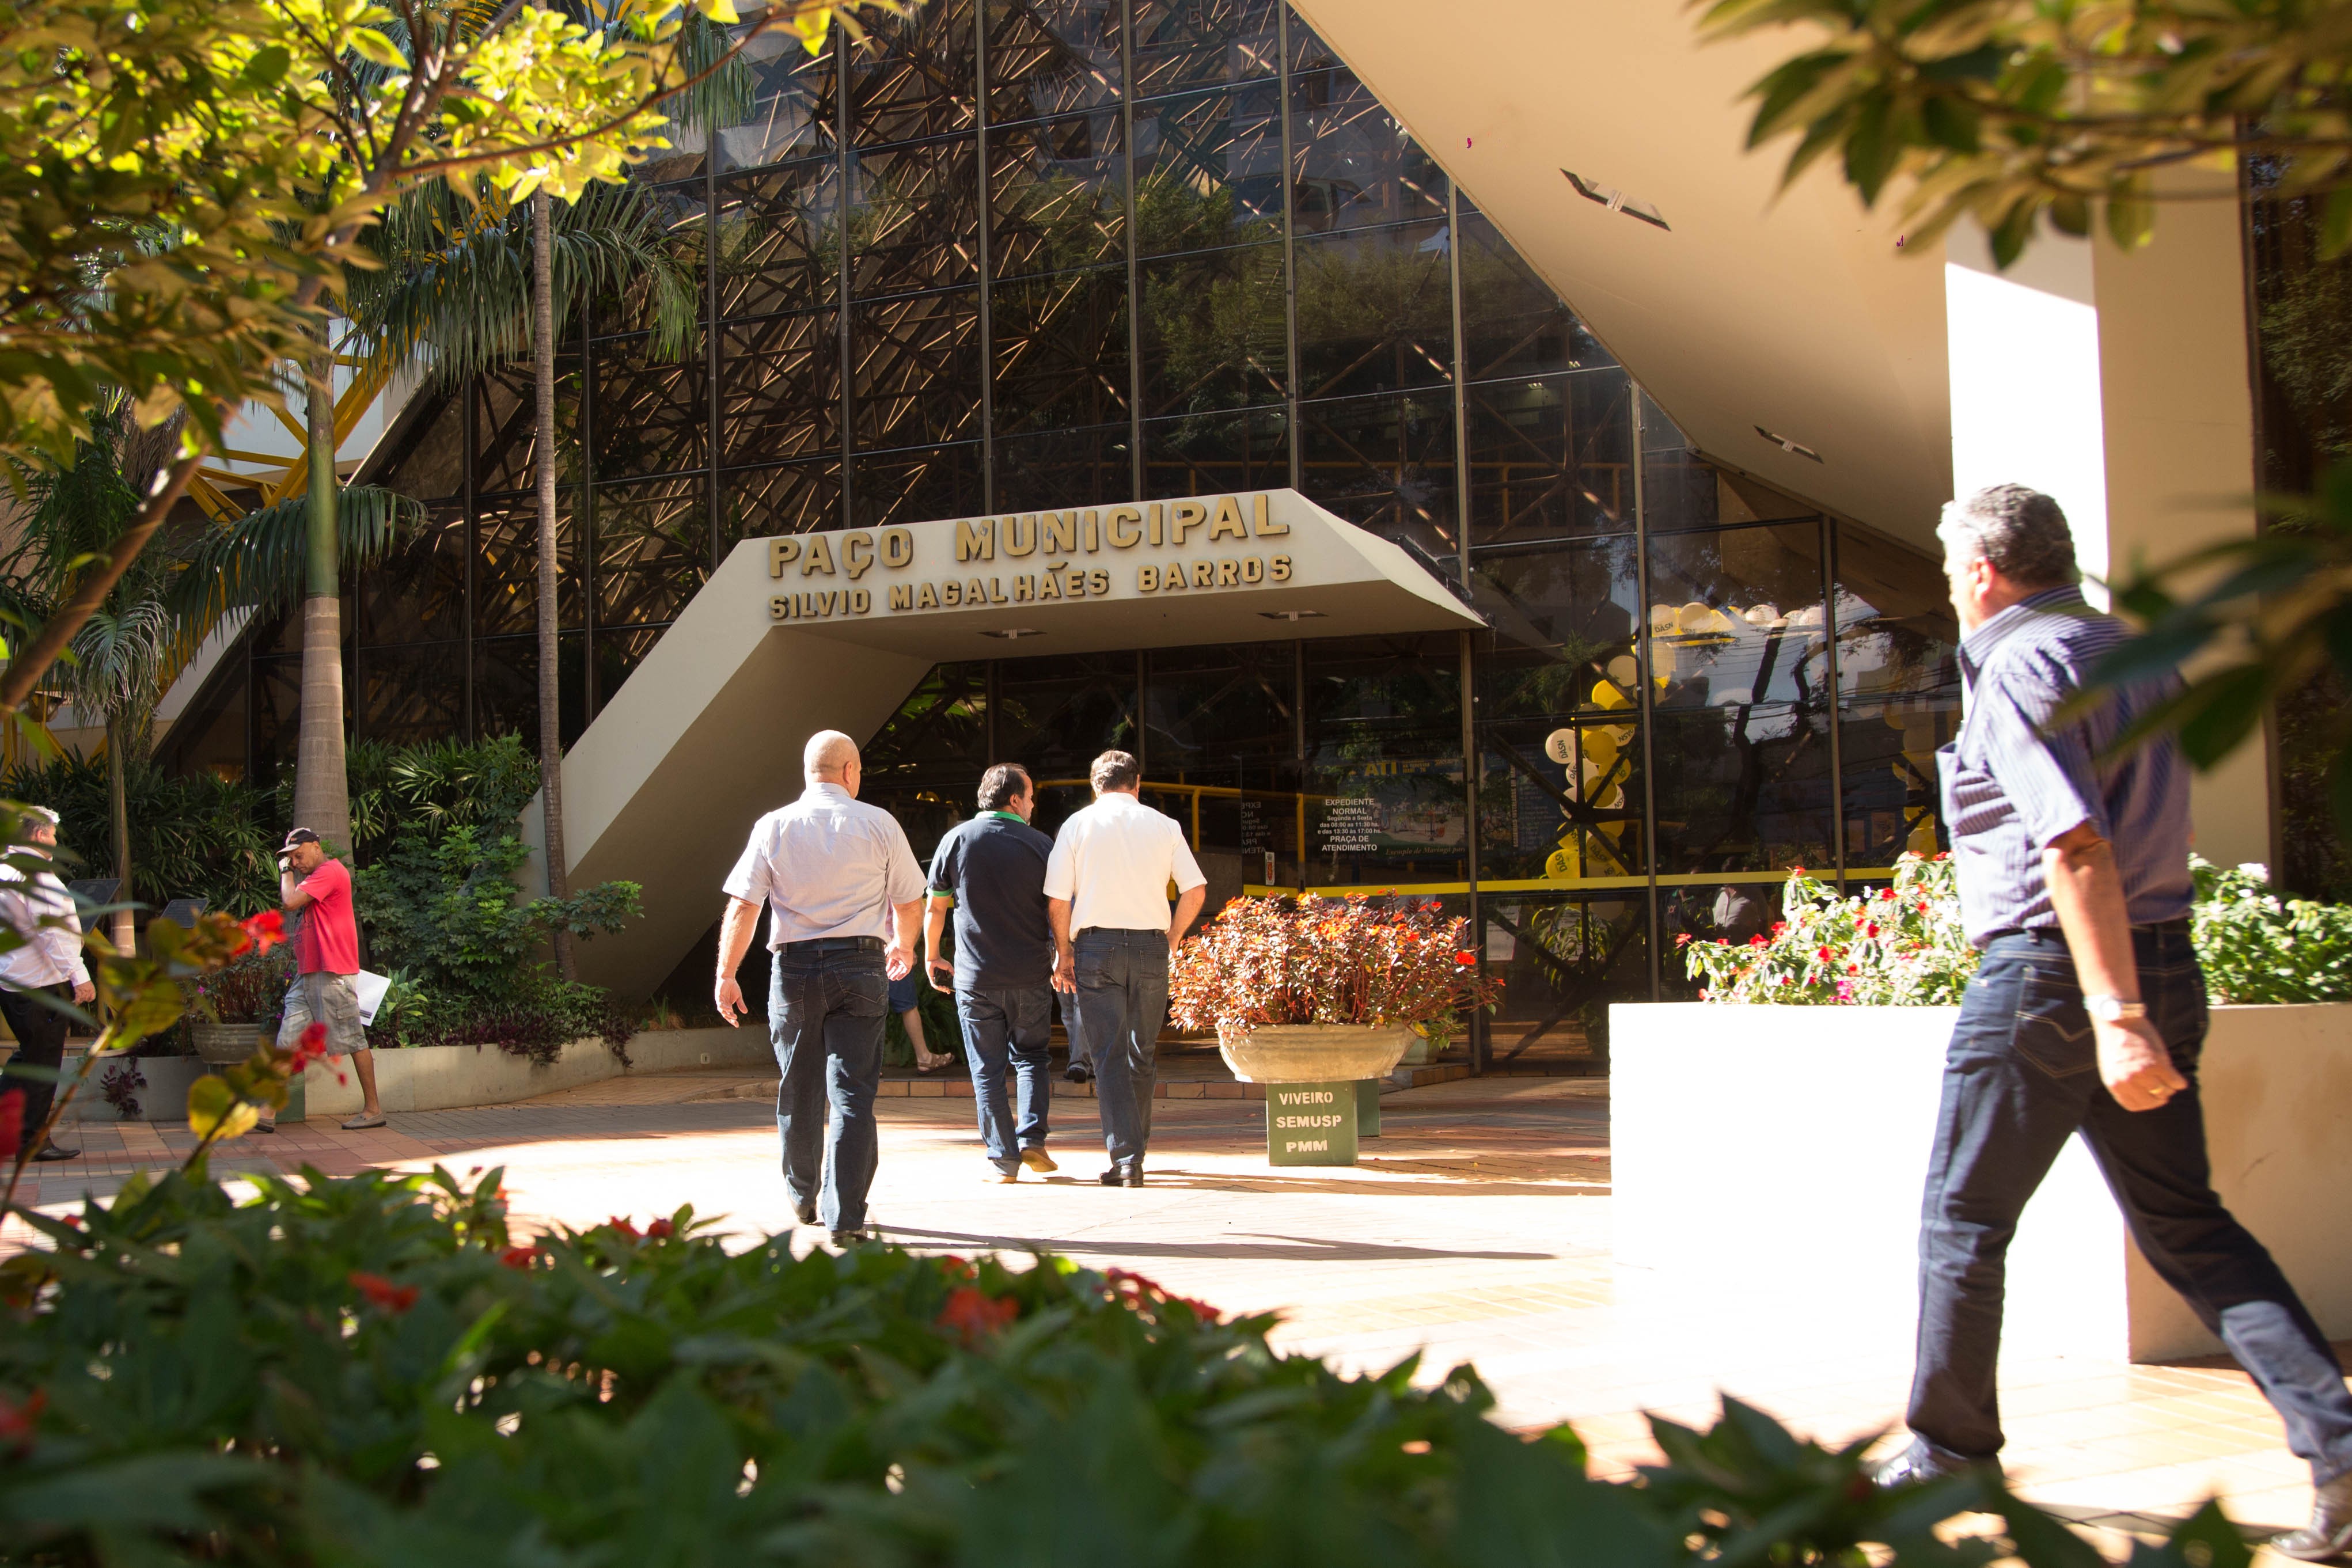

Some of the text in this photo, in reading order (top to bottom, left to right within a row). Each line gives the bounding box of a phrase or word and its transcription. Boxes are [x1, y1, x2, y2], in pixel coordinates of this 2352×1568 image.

[769, 494, 1290, 579] PAÇO MUNICIPAL
[769, 589, 871, 619] SILVIO
[1138, 555, 1292, 591] BARROS
[1655, 622, 1674, 632] DASN
[1557, 739, 1568, 758] DASN
[1279, 1092, 1333, 1105] VIVEIRO
[1276, 1115, 1342, 1128] SEMUSP
[1286, 1140, 1327, 1152] PMM
